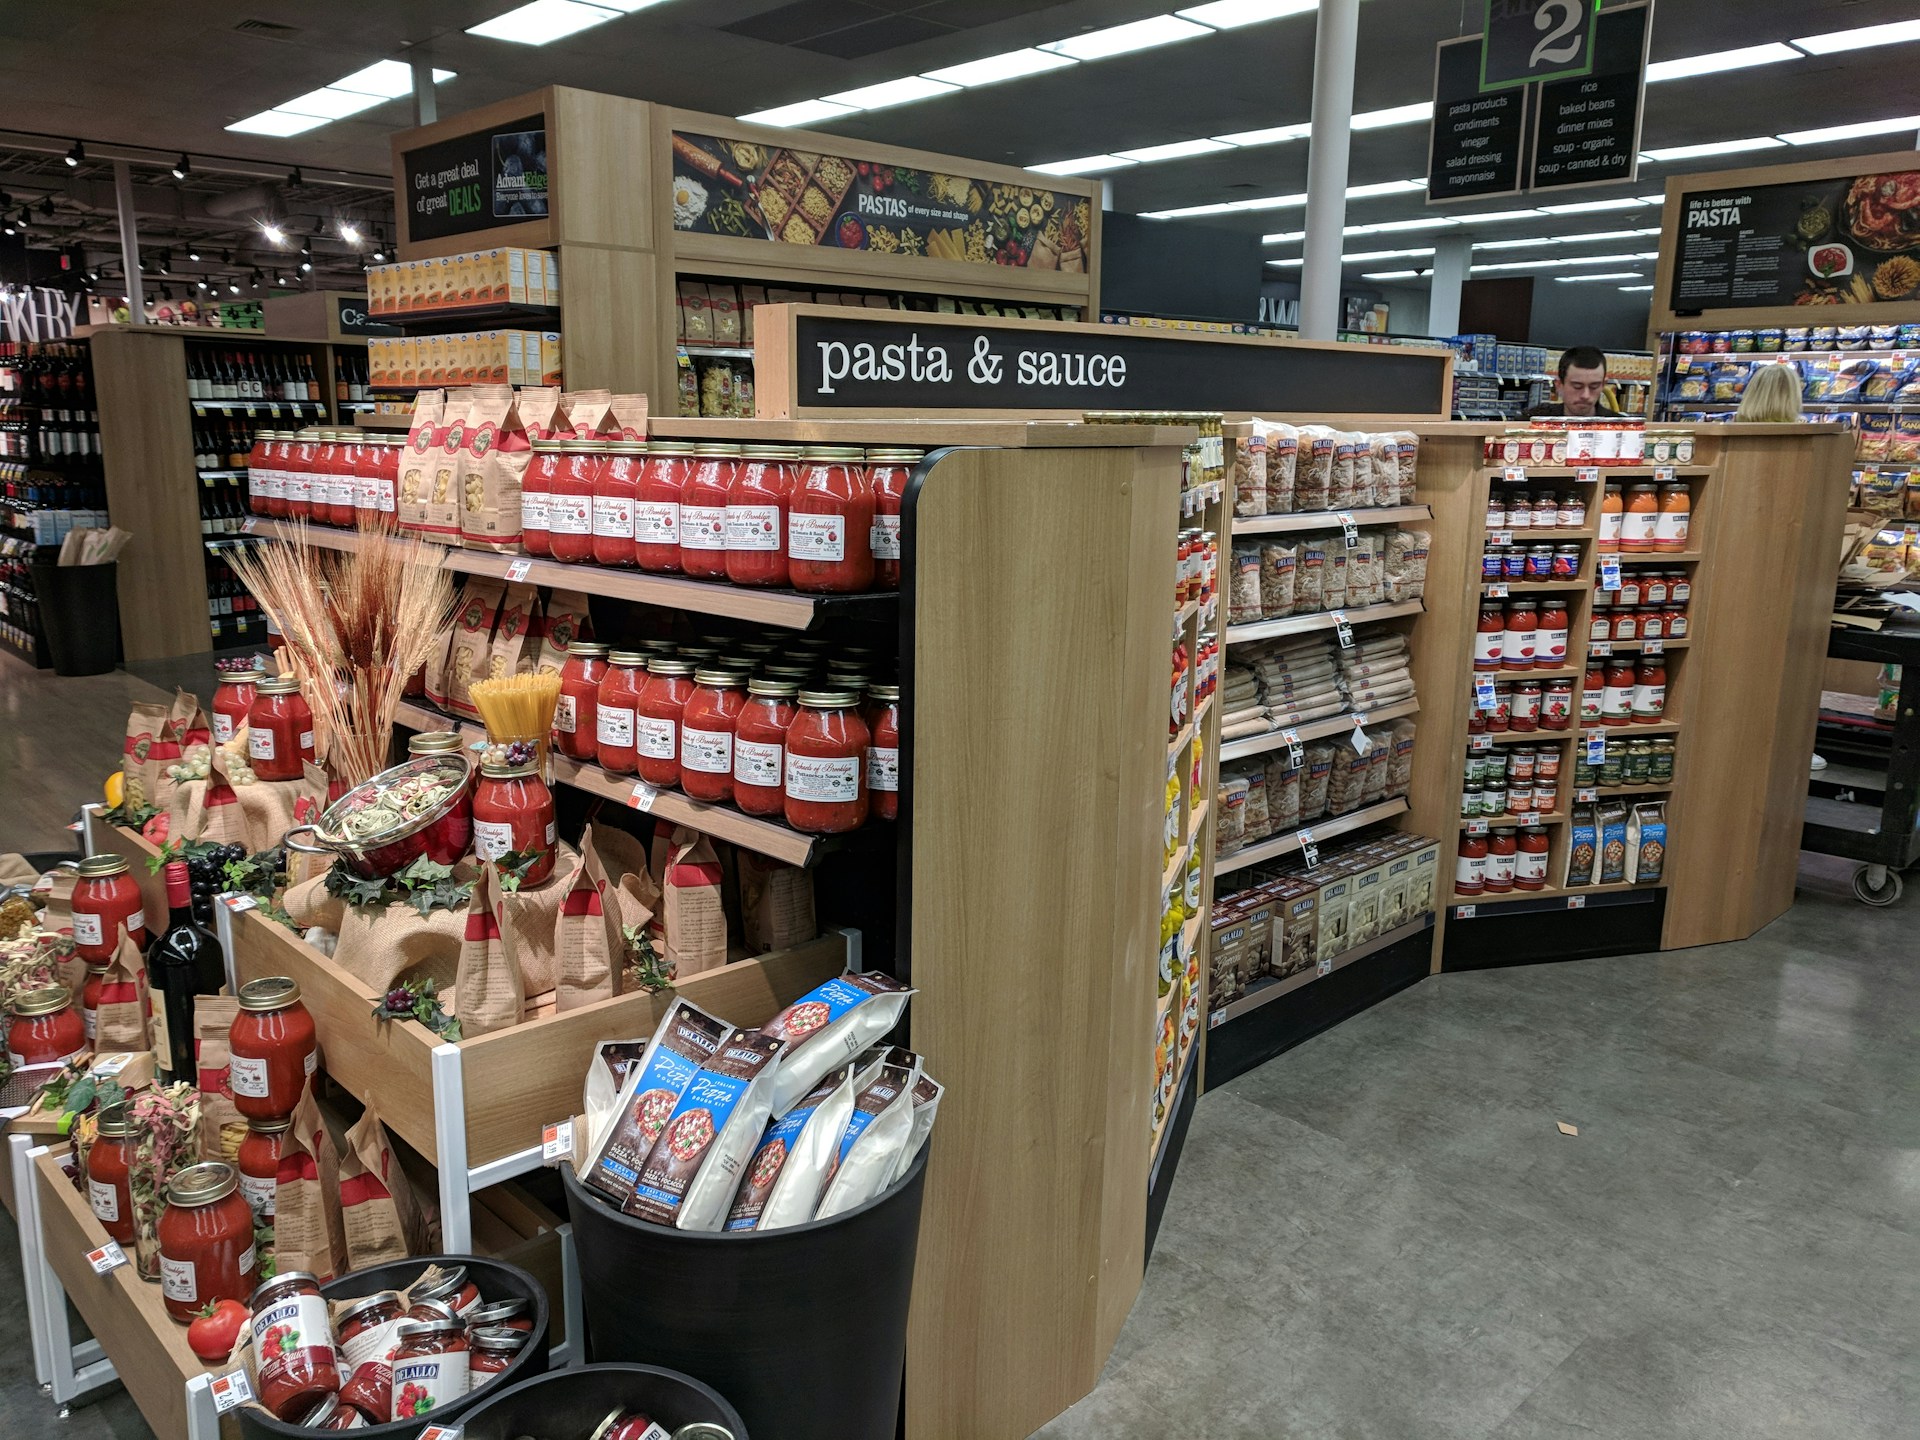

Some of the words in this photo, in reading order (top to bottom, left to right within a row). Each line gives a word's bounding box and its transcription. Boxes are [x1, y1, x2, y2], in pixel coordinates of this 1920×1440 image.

[1529, 0, 1583, 68] 2
[1581, 82, 1597, 93] rice
[1449, 104, 1470, 116] pasta
[1472, 97, 1507, 112] products
[1560, 100, 1586, 115] baked
[1589, 98, 1615, 111] beans
[1454, 117, 1500, 132] condiments
[1558, 123, 1585, 134] dinner
[1588, 118, 1613, 129] mixes
[1461, 136, 1489, 148] vinegar
[1554, 142, 1574, 154] soup
[1582, 136, 1615, 151] organic
[1446, 156, 1466, 168] salad
[1469, 152, 1502, 165] dressing
[1539, 161, 1559, 174] soup
[1568, 158, 1599, 170] canned
[1601, 154, 1610, 165] &
[1612, 154, 1626, 167] dry
[415, 171, 429, 189] Get
[431, 175, 436, 186] a
[438, 165, 460, 188] great
[461, 159, 479, 179] deal
[1449, 171, 1495, 184] mayonnaise
[417, 194, 425, 213] of
[427, 192, 448, 214] great
[449, 184, 481, 216] DEALS
[859, 194, 907, 218] PASTAS
[908, 205, 914, 214] of
[915, 207, 930, 217] every
[931, 208, 941, 217] size
[942, 210, 952, 218] and
[953, 211, 969, 221] shape
[1690, 200, 1701, 209] life
[1703, 199, 1709, 207] is
[1712, 197, 1733, 207] better
[1735, 196, 1752, 205] with
[1687, 207, 1741, 228] PASTA
[817, 332, 952, 394] pasta
[967, 334, 1003, 386] &
[1017, 350, 1127, 388] sauce
[693, 511, 720, 523] Brooklyn
[742, 510, 771, 524] Brooklyn
[806, 519, 836, 532] Brooklyn
[604, 711, 626, 721] Brooklyn
[644, 722, 667, 733] Brooklyn
[697, 734, 724, 746] Brooklyn
[746, 746, 773, 760] Brooklyn
[790, 759, 813, 771] Michaels
[814, 763, 819, 774] of
[821, 762, 852, 774] Brooklyn
[1293, 899, 1313, 914] DELALLO
[1220, 929, 1243, 943] DELALLO
[820, 983, 854, 1005] Pizza
[679, 1028, 716, 1053] DELALLO
[727, 1050, 761, 1063] DELALLO
[654, 1055, 692, 1086] Pizz
[679, 1064, 692, 1074] ITAL
[656, 1074, 680, 1089] DOUGH
[715, 1081, 736, 1089] ITALIAN
[691, 1078, 732, 1103] Pizza
[692, 1096, 712, 1104] DOUGH
[611, 1147, 627, 1160] PIZZA
[644, 1173, 658, 1181] PIZZA
[661, 1176, 684, 1189] FOCACCIA
[256, 1308, 296, 1334] DELALLO
[282, 1352, 308, 1364] Sauce
[396, 1365, 438, 1382] DELALLO
